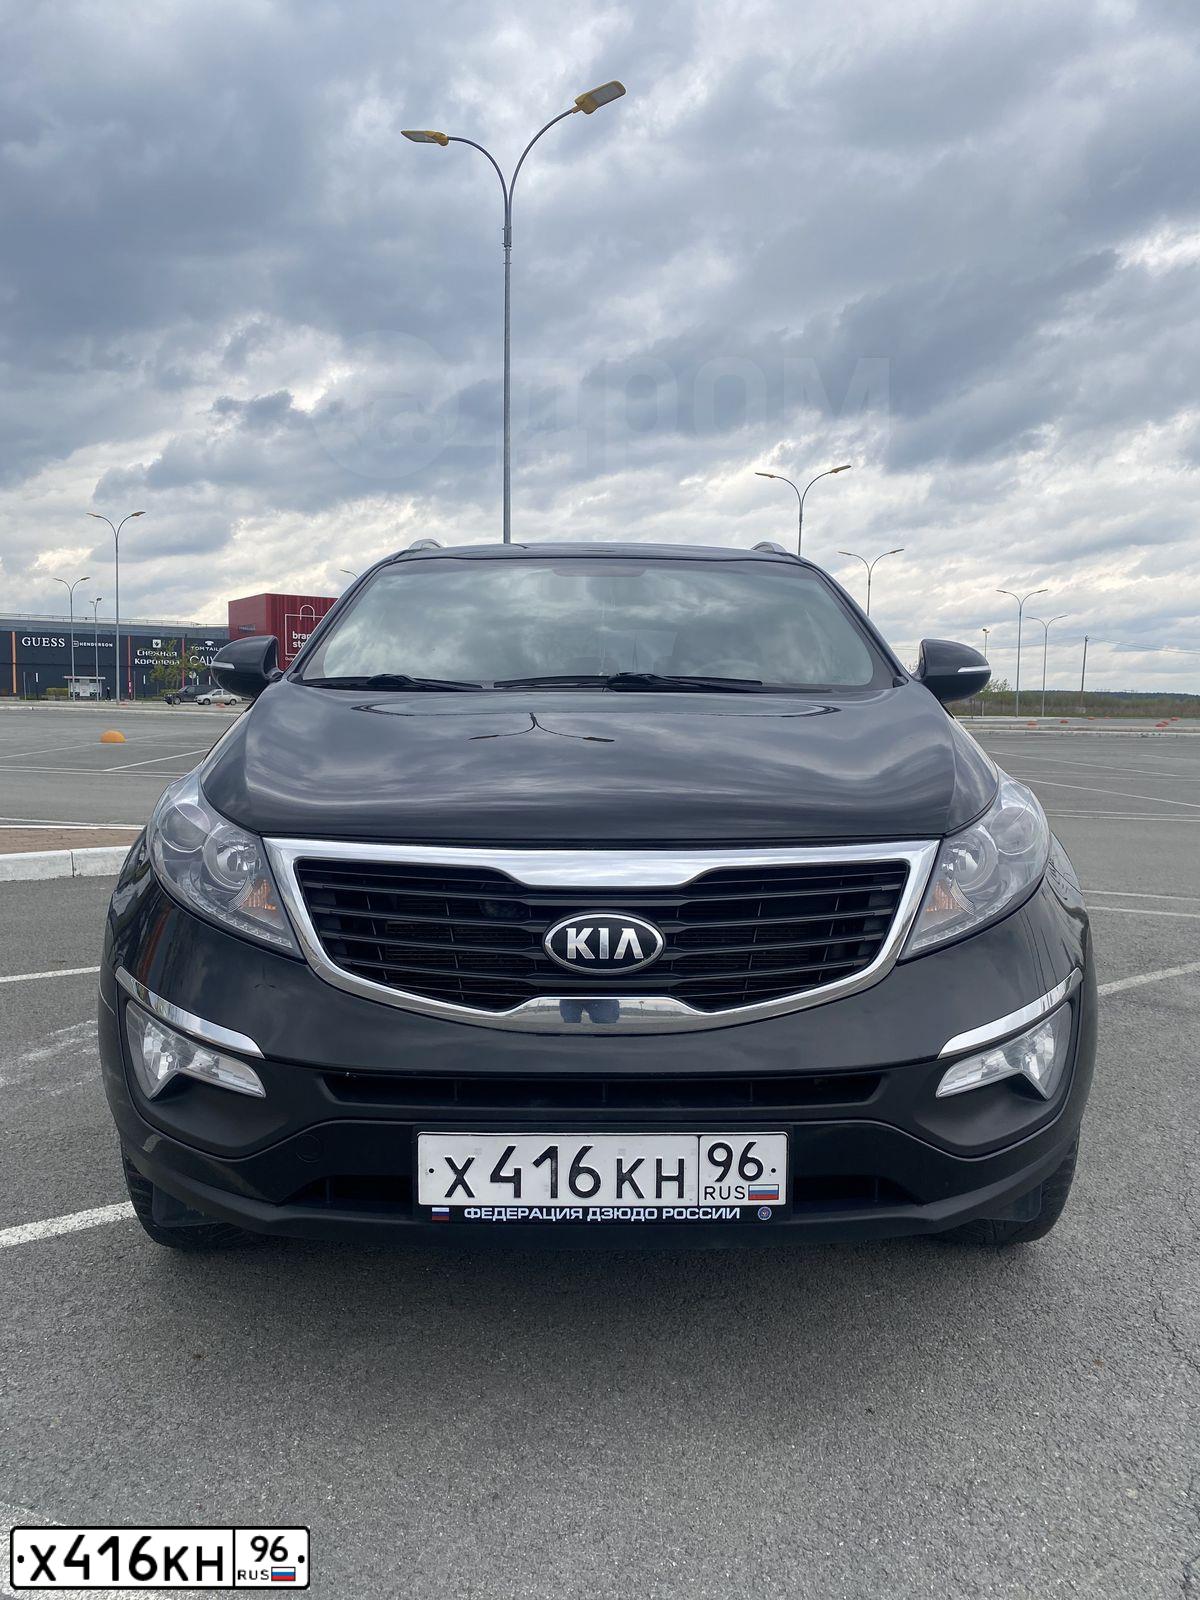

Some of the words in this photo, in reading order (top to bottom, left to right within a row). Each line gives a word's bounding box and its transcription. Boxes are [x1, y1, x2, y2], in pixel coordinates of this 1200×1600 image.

[22, 636, 66, 648] GUESS
[566, 927, 645, 959] KIA
[444, 1145, 685, 1199] Х416КН
[707, 1141, 764, 1183] 96
[704, 1185, 746, 1201] RUS
[463, 1207, 583, 1221] ФЕДЕРАЦИЯ
[589, 1207, 658, 1222] ДЗЮДО
[662, 1207, 741, 1220] РОССИИ
